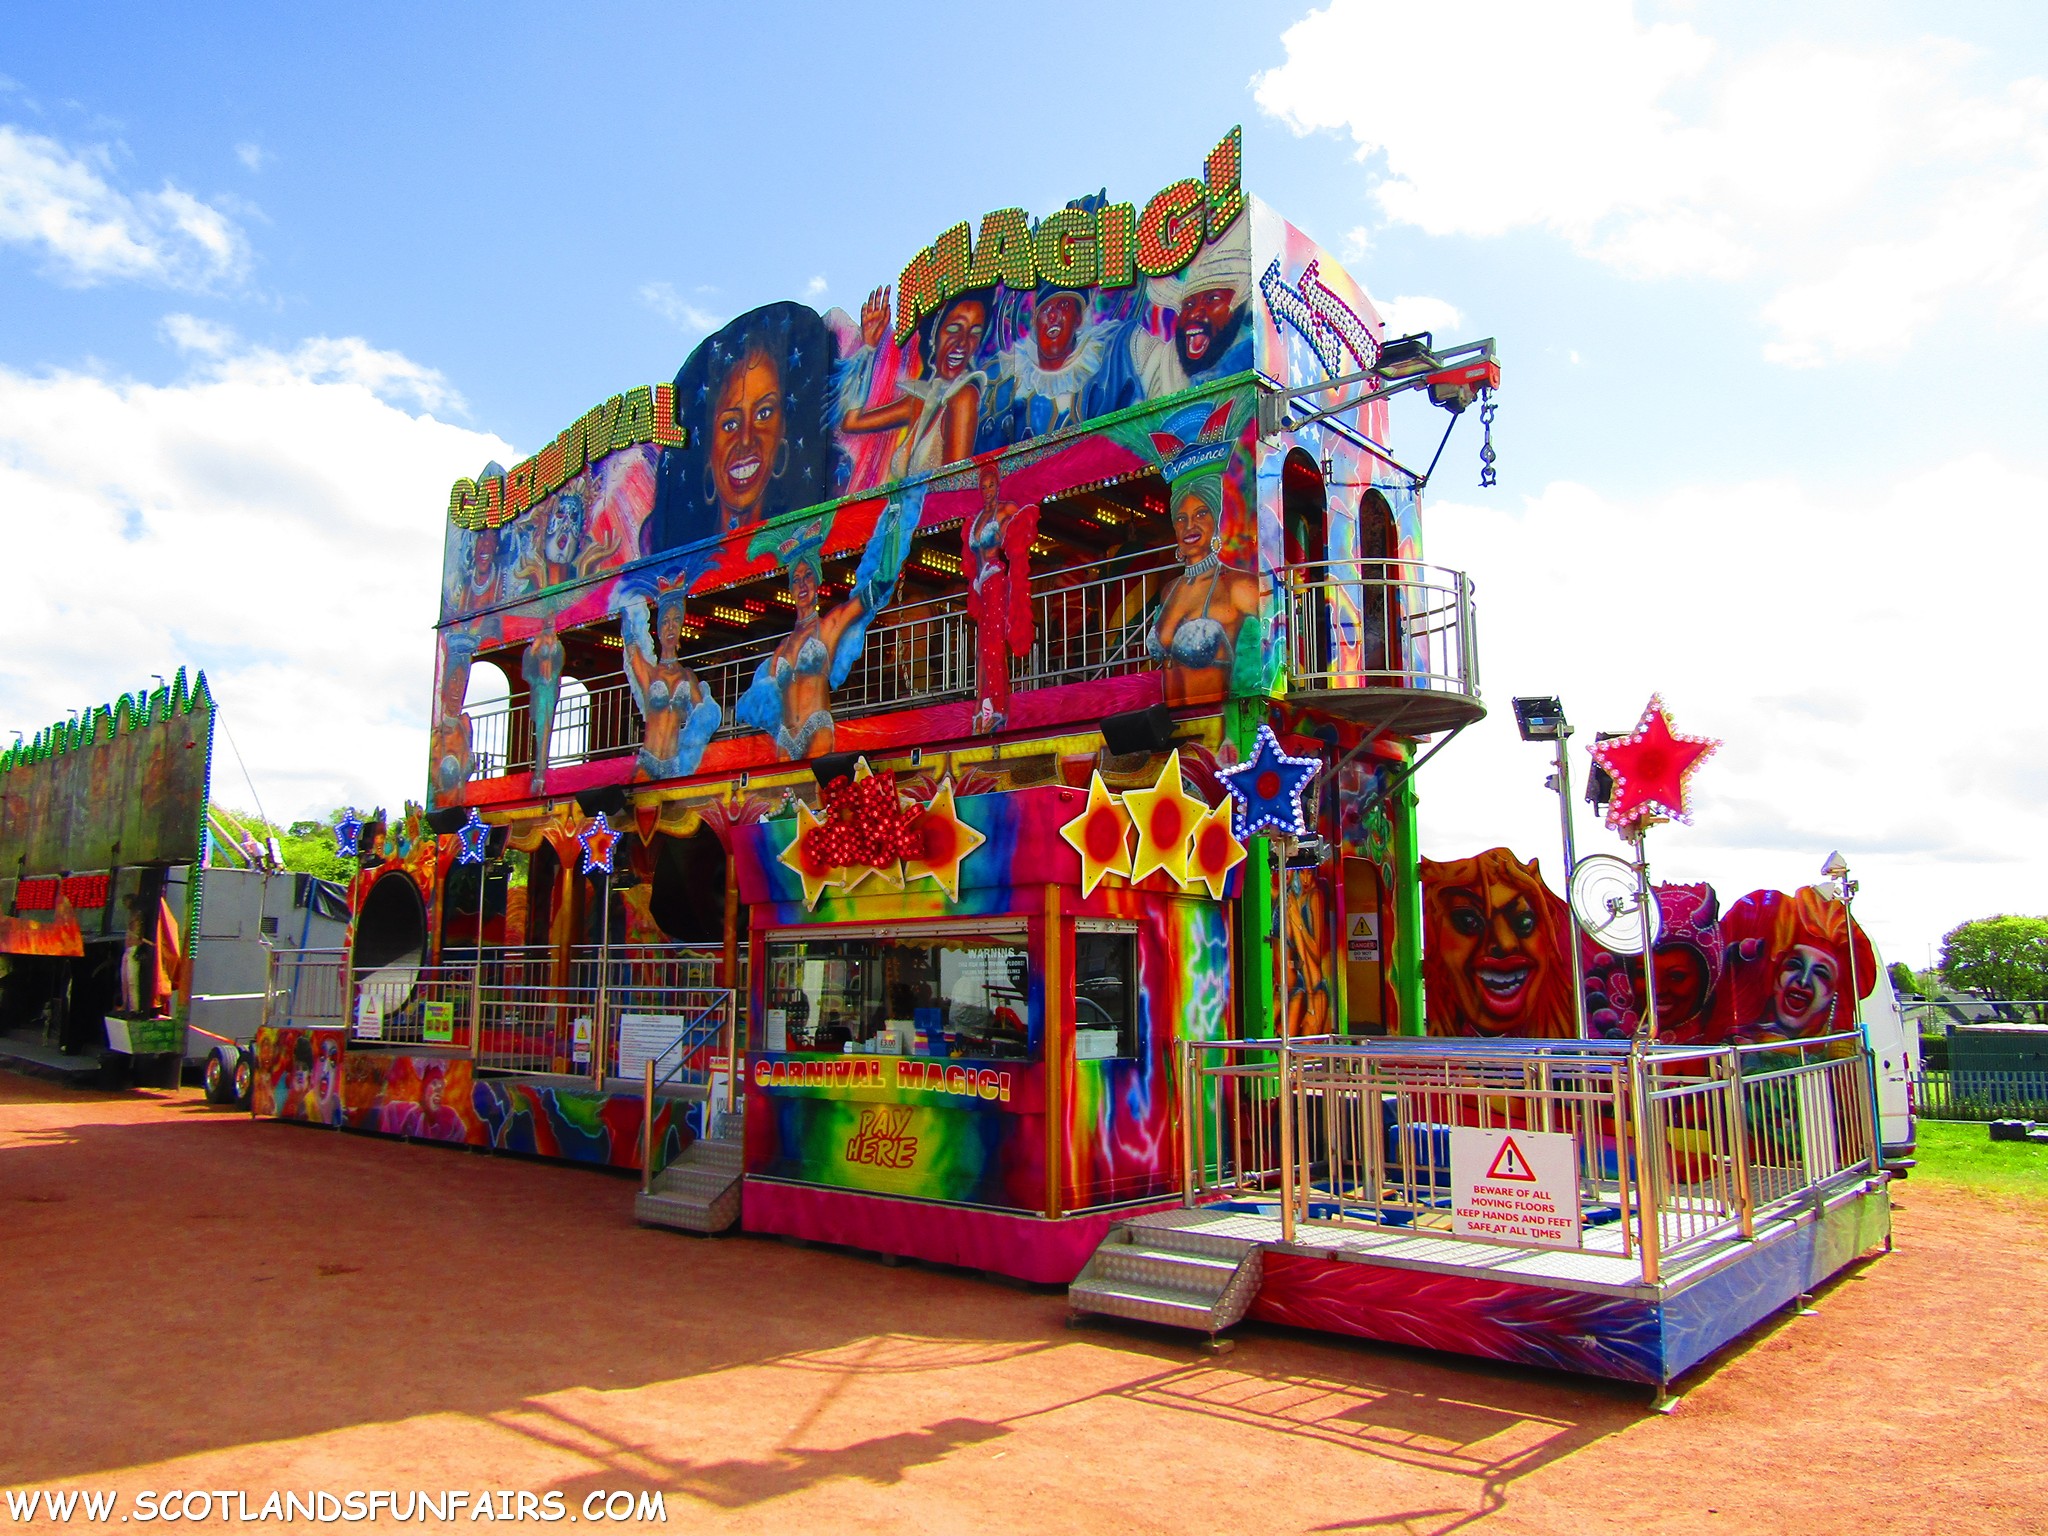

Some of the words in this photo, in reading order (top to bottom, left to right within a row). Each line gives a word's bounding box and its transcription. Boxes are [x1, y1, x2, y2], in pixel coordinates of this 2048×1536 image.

[450, 381, 688, 531] CARNIVAL
[895, 124, 1243, 347] MAGIC!
[1163, 447, 1225, 480] Experience
[967, 947, 1015, 958] WARNING
[755, 1061, 886, 1088] CARNIVAL
[897, 1061, 1011, 1102] MAGIC!
[860, 1107, 914, 1138] PAY
[846, 1136, 918, 1168] HERE
[1471, 1197, 1513, 1209] MOVING
[1515, 1201, 1555, 1213] FLOORS
[1473, 1185, 1514, 1197] BEWARE
[1516, 1189, 1530, 1198] OF
[1532, 1190, 1552, 1200] ALL
[1456, 1208, 1480, 1218] KEEP
[1482, 1210, 1519, 1222] HANDS
[1521, 1215, 1545, 1225] AND
[1548, 1217, 1572, 1228] FEET
[1467, 1221, 1493, 1232] SAFE
[1494, 1224, 1507, 1233] AT
[1509, 1226, 1528, 1236] ALL
[1530, 1227, 1561, 1239] TIMES
